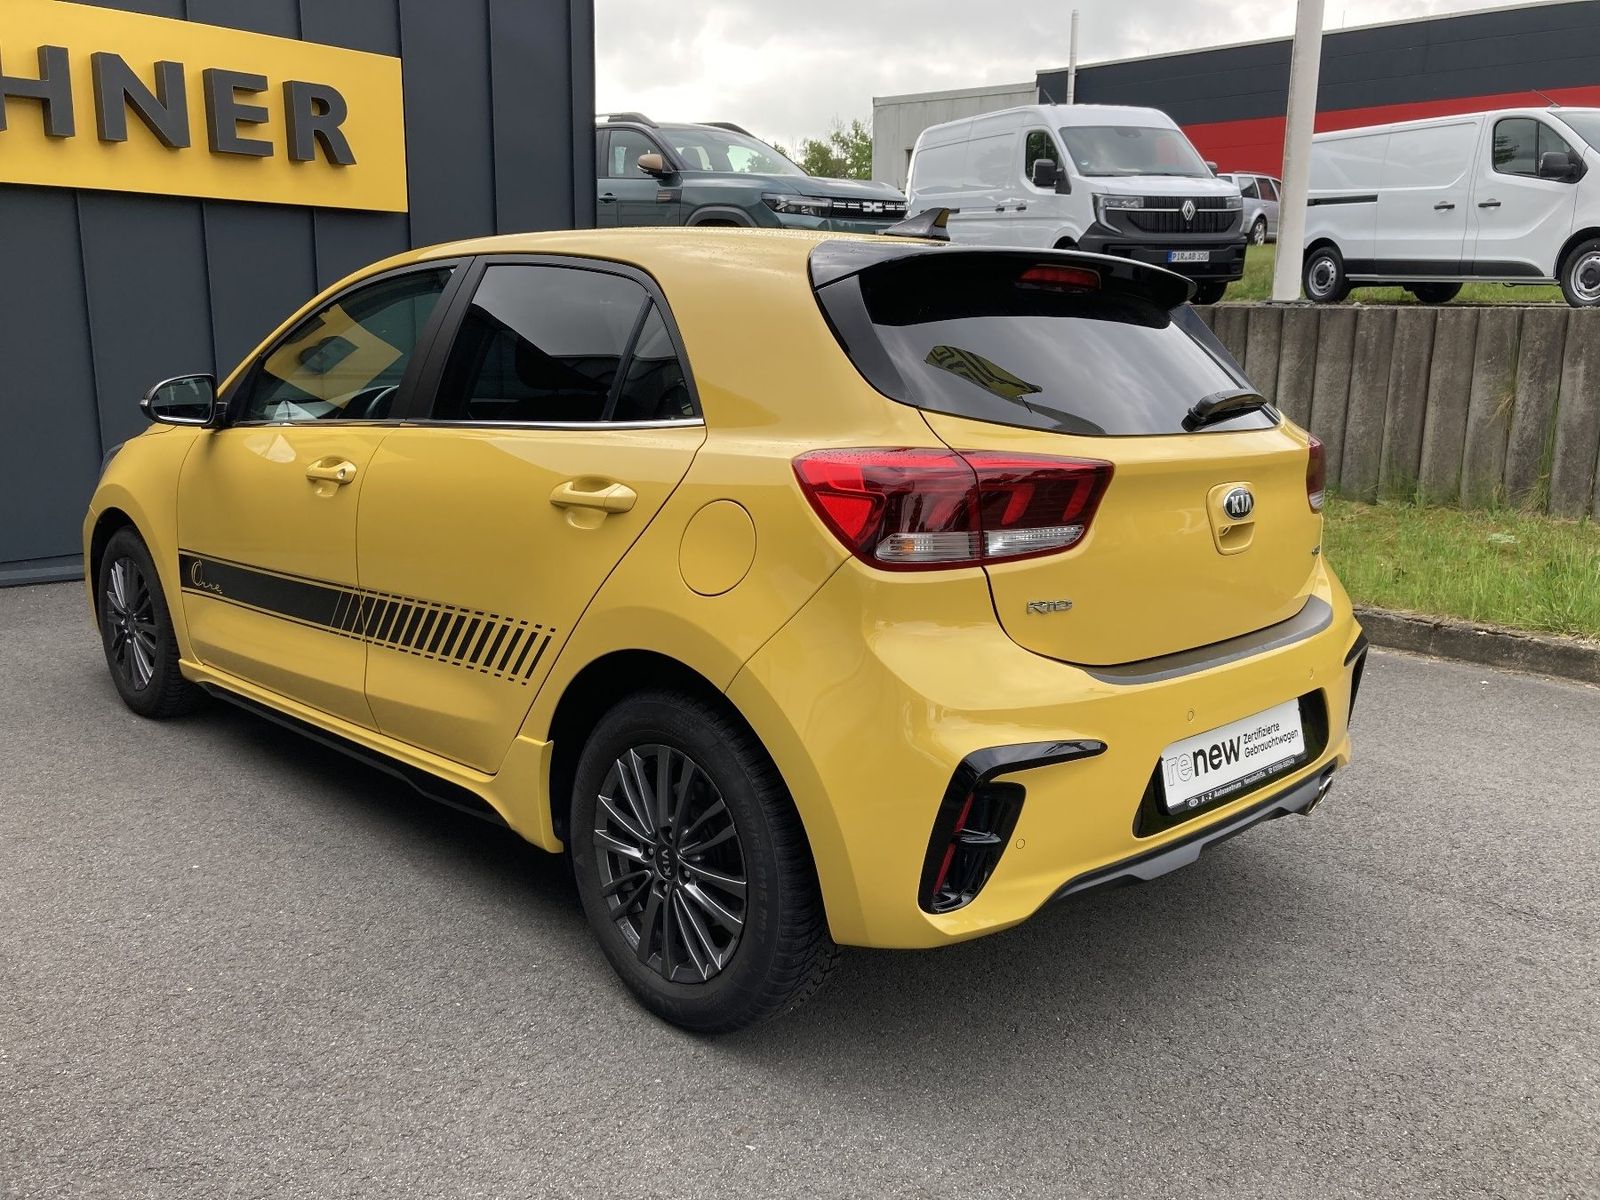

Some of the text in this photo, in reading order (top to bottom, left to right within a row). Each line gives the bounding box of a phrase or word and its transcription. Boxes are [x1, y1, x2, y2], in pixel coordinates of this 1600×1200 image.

[0, 45, 357, 166] HNER
[1230, 493, 1251, 514] KIA
[1026, 599, 1073, 615] RIO
[1243, 722, 1280, 745] Zertifizierte
[1244, 729, 1299, 758] Gebrauchtwagen
[1166, 736, 1241, 787] renew
[663, 849, 673, 877] KIA
